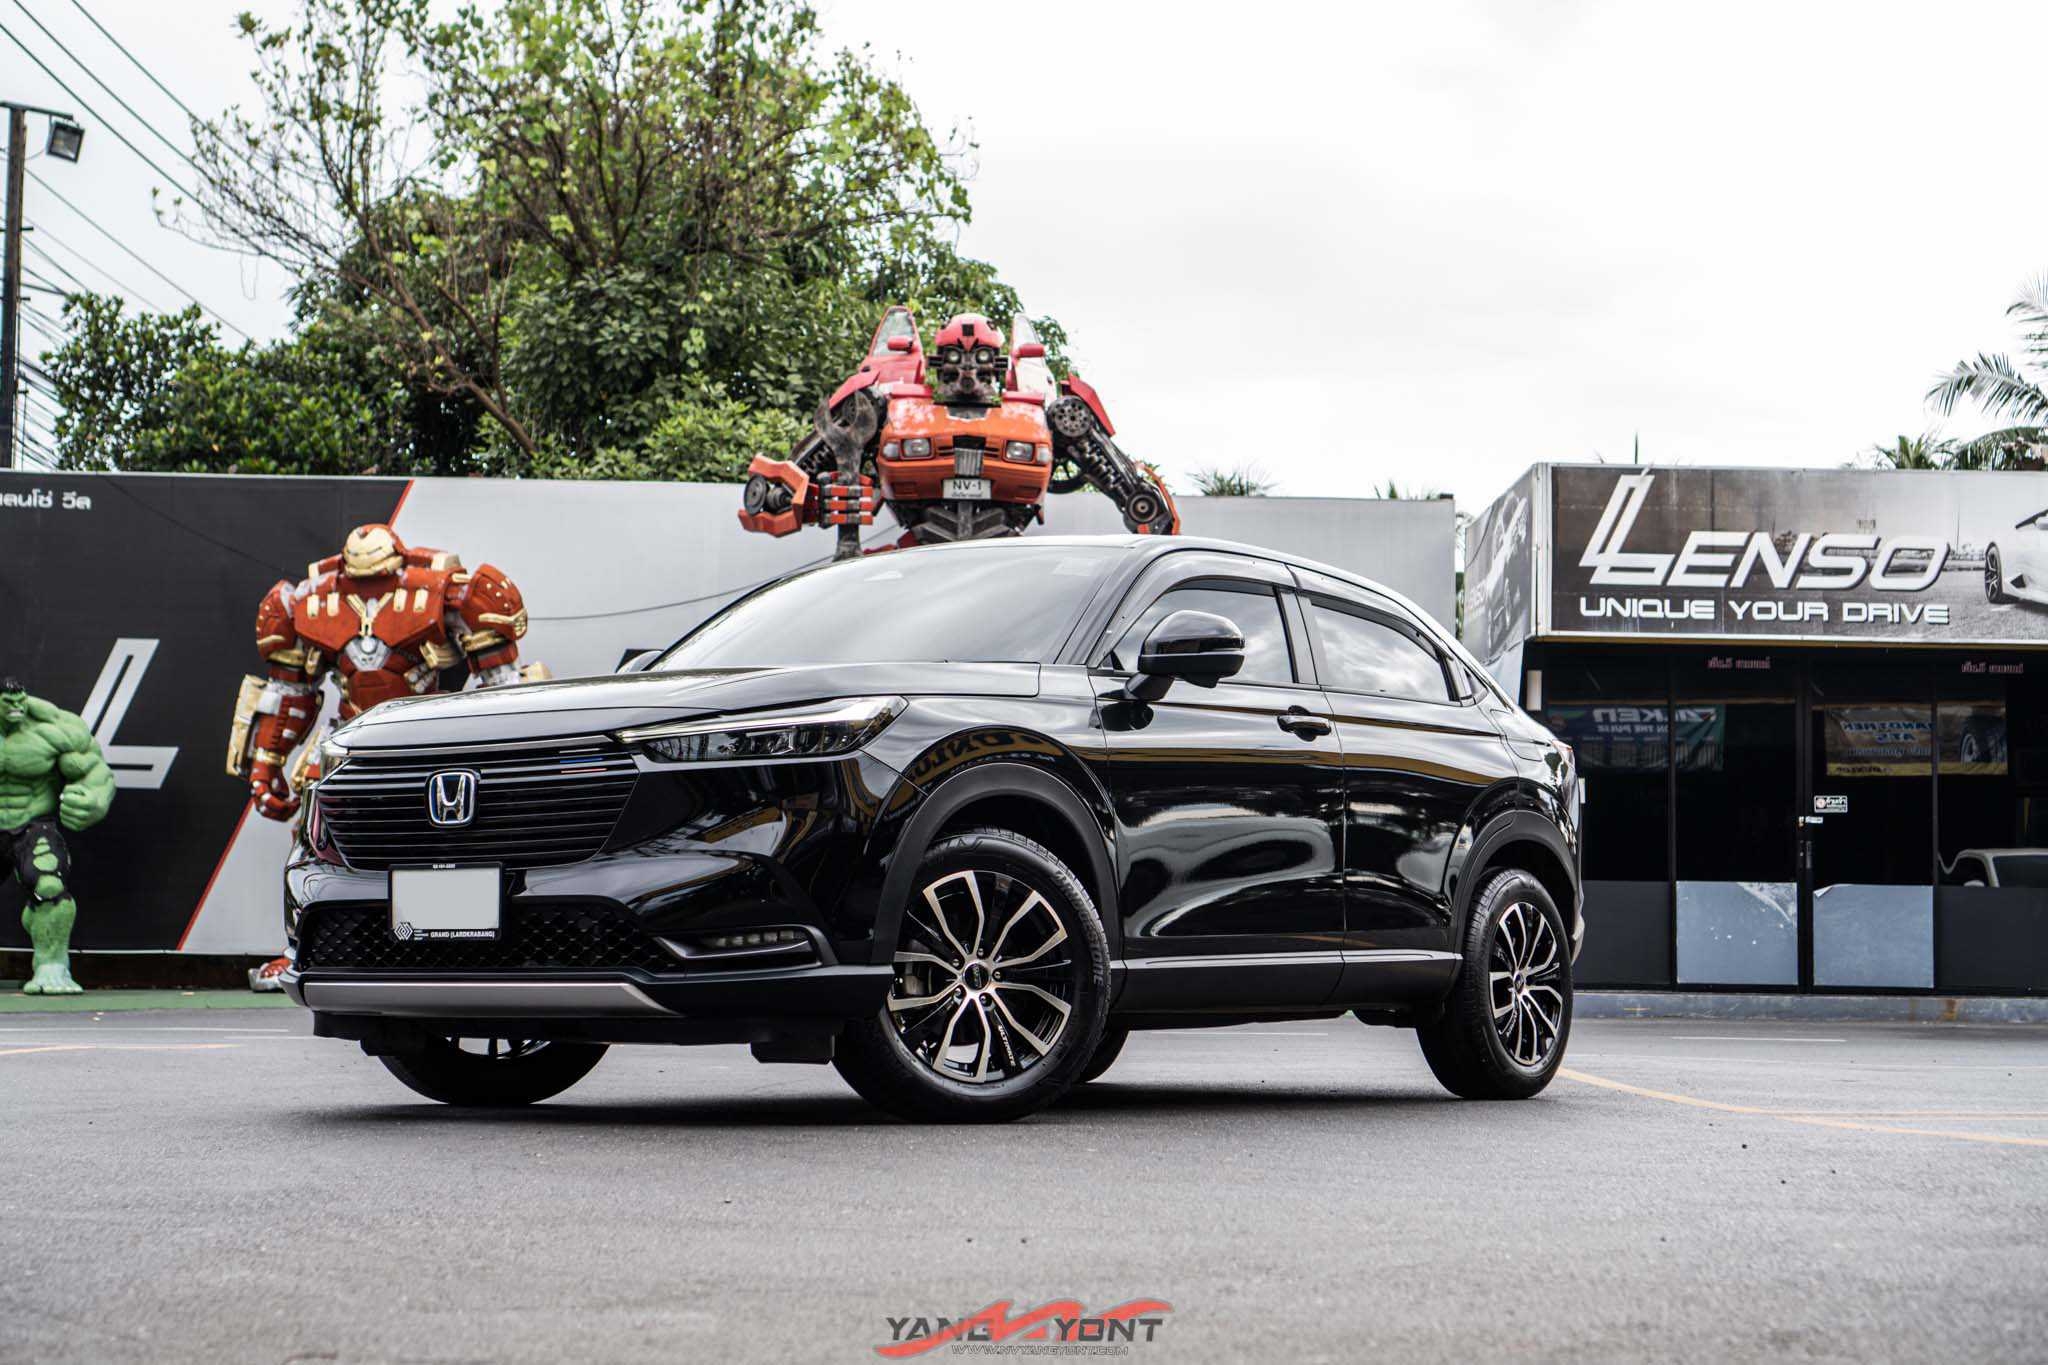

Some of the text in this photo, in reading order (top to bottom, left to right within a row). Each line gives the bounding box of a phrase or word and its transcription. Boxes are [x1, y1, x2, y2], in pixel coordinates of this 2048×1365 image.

[953, 480, 981, 490] NV-1
[1579, 475, 1950, 592] LENSO
[1579, 596, 1950, 625] UNIQUE YOUR DRIVE
